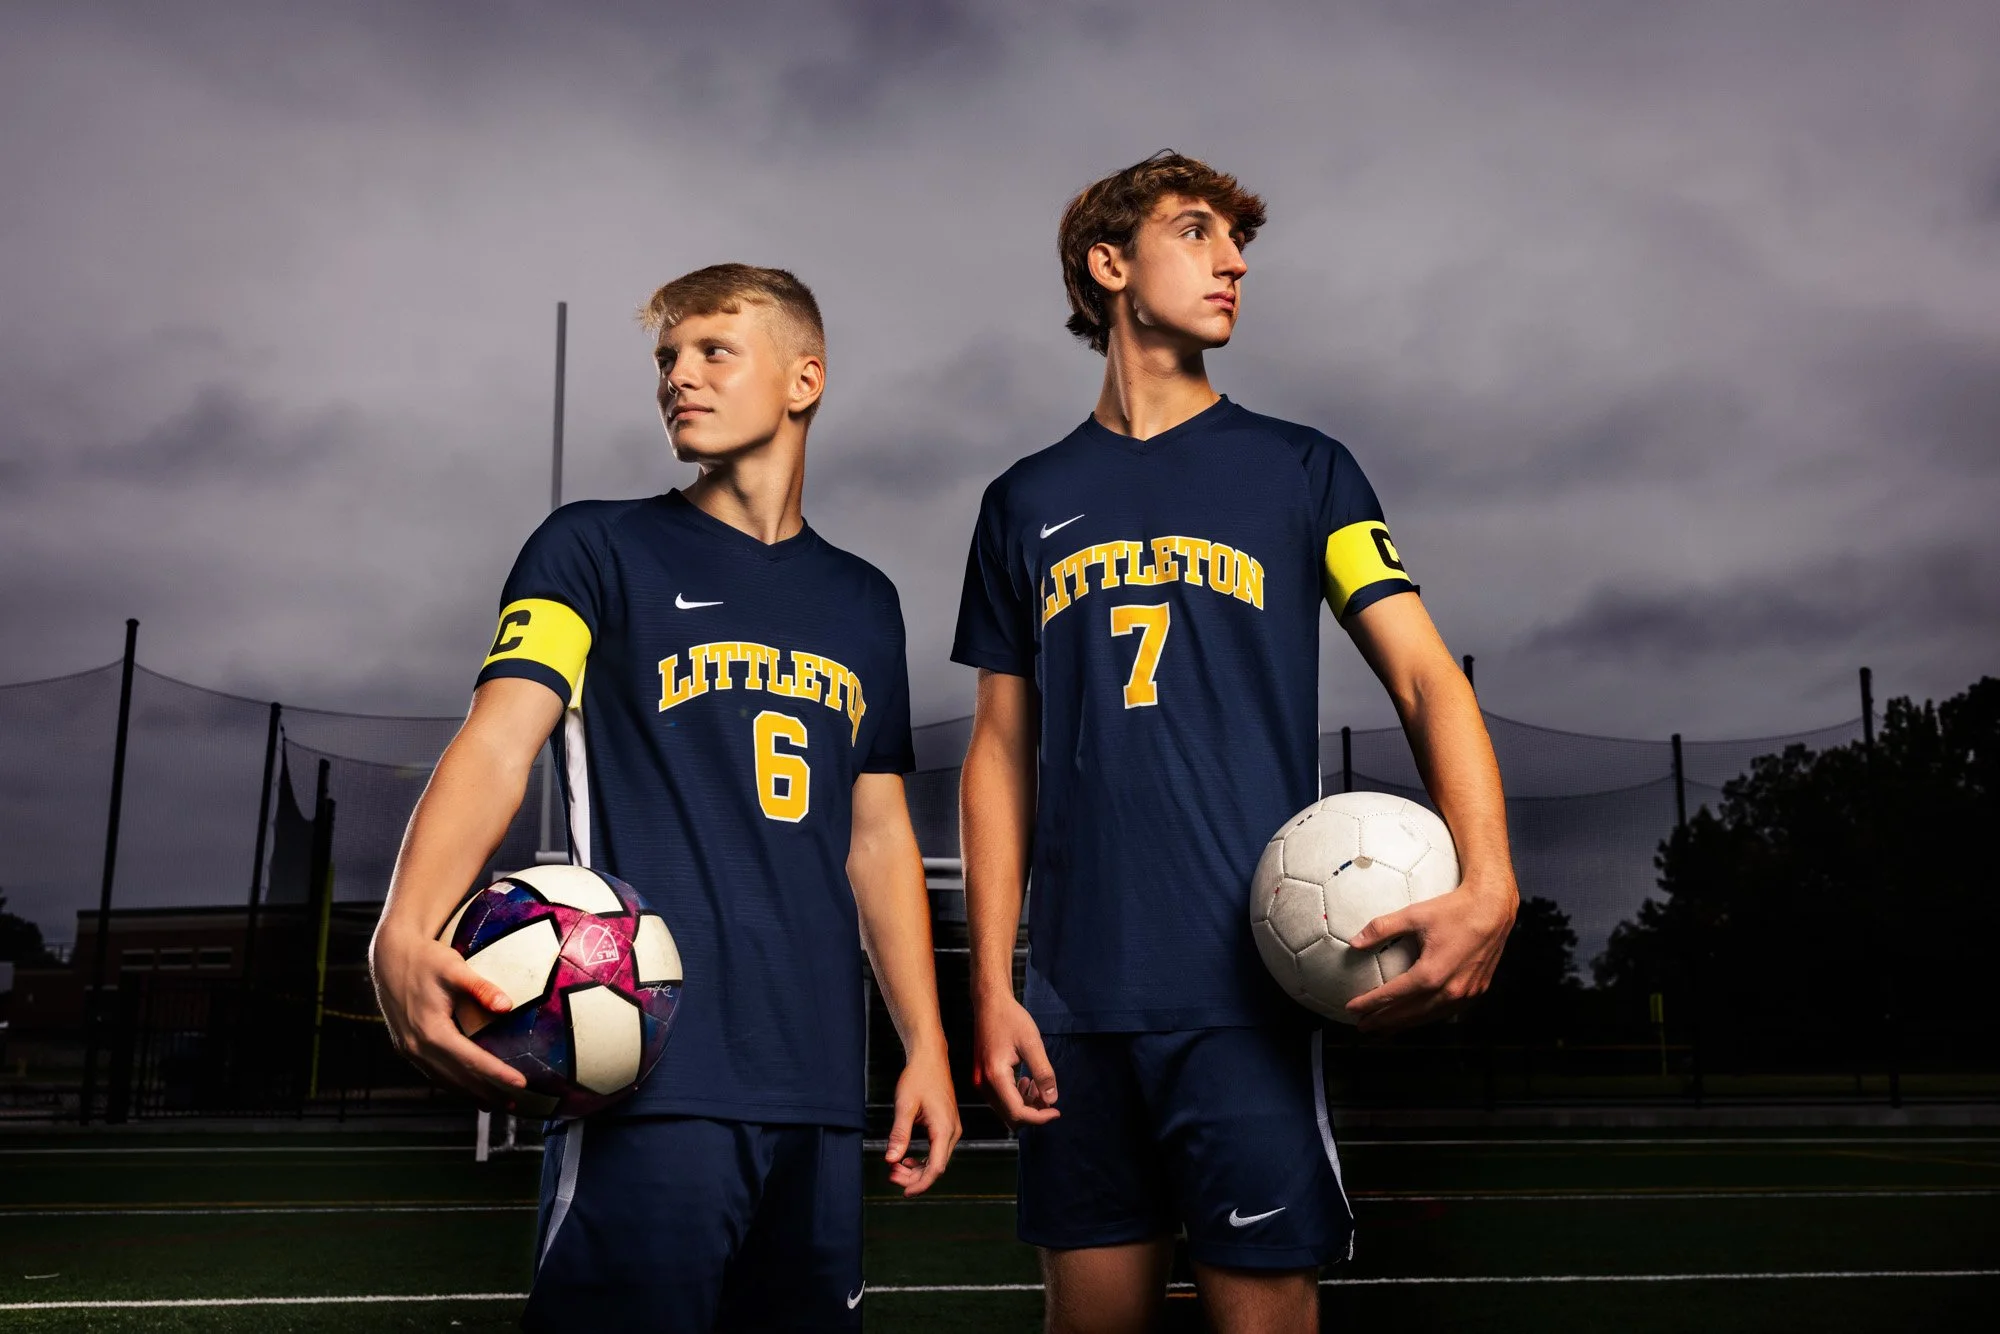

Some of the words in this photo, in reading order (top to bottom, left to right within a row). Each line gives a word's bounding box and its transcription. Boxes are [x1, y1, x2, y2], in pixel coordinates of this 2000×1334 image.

[1041, 535, 1264, 632] LITTLETON
[1370, 528, 1405, 573] C
[489, 609, 531, 657] C
[1110, 602, 1170, 709] 7
[658, 641, 867, 748] LITTLETO
[753, 710, 810, 823] 6
[596, 949, 616, 960] MLS
